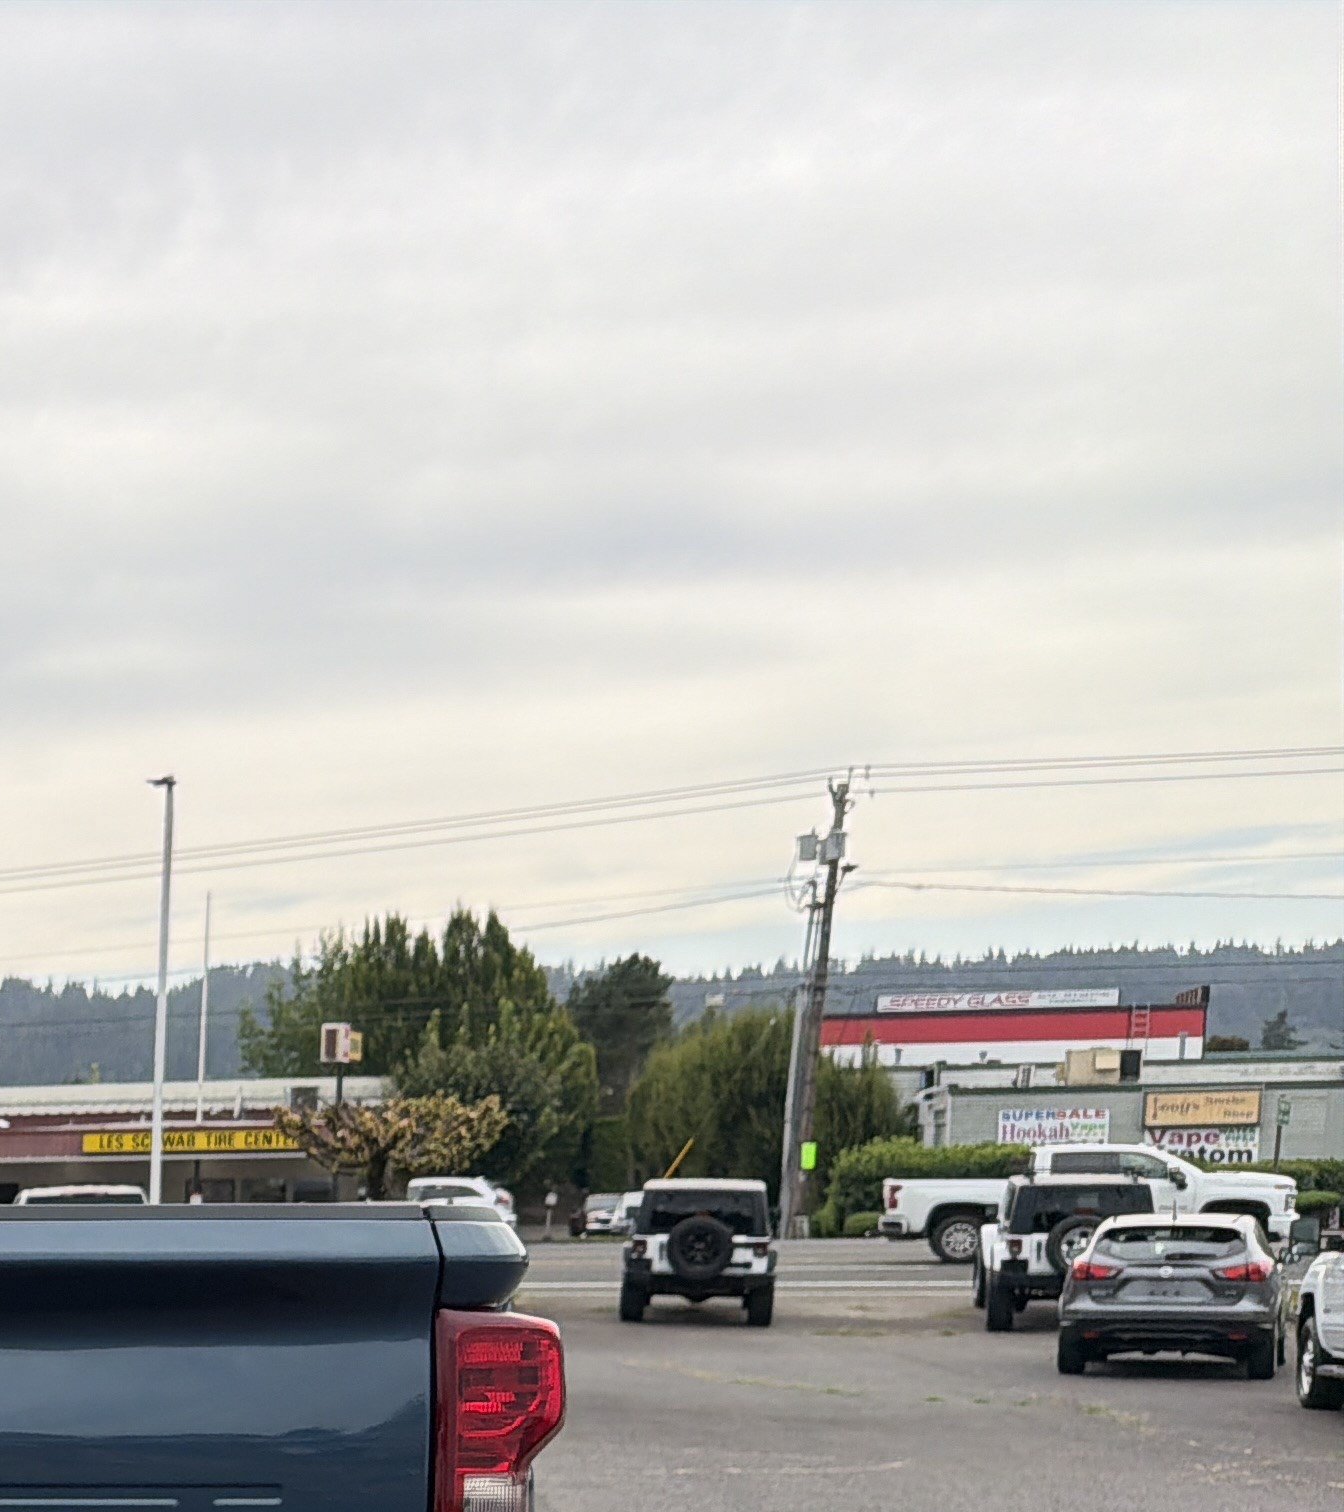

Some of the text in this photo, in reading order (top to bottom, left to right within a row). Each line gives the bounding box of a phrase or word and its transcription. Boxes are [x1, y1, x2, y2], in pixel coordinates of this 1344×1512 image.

[885, 993, 963, 1010] SPEEDY
[967, 991, 1032, 1007] GLASS
[1002, 1122, 1070, 1140] Hookah
[1148, 1128, 1220, 1147] Vape
[98, 1134, 124, 1150] LES
[131, 1133, 196, 1149] SCWAB
[205, 1132, 236, 1148] TIRE
[1157, 1145, 1253, 1163] atom
